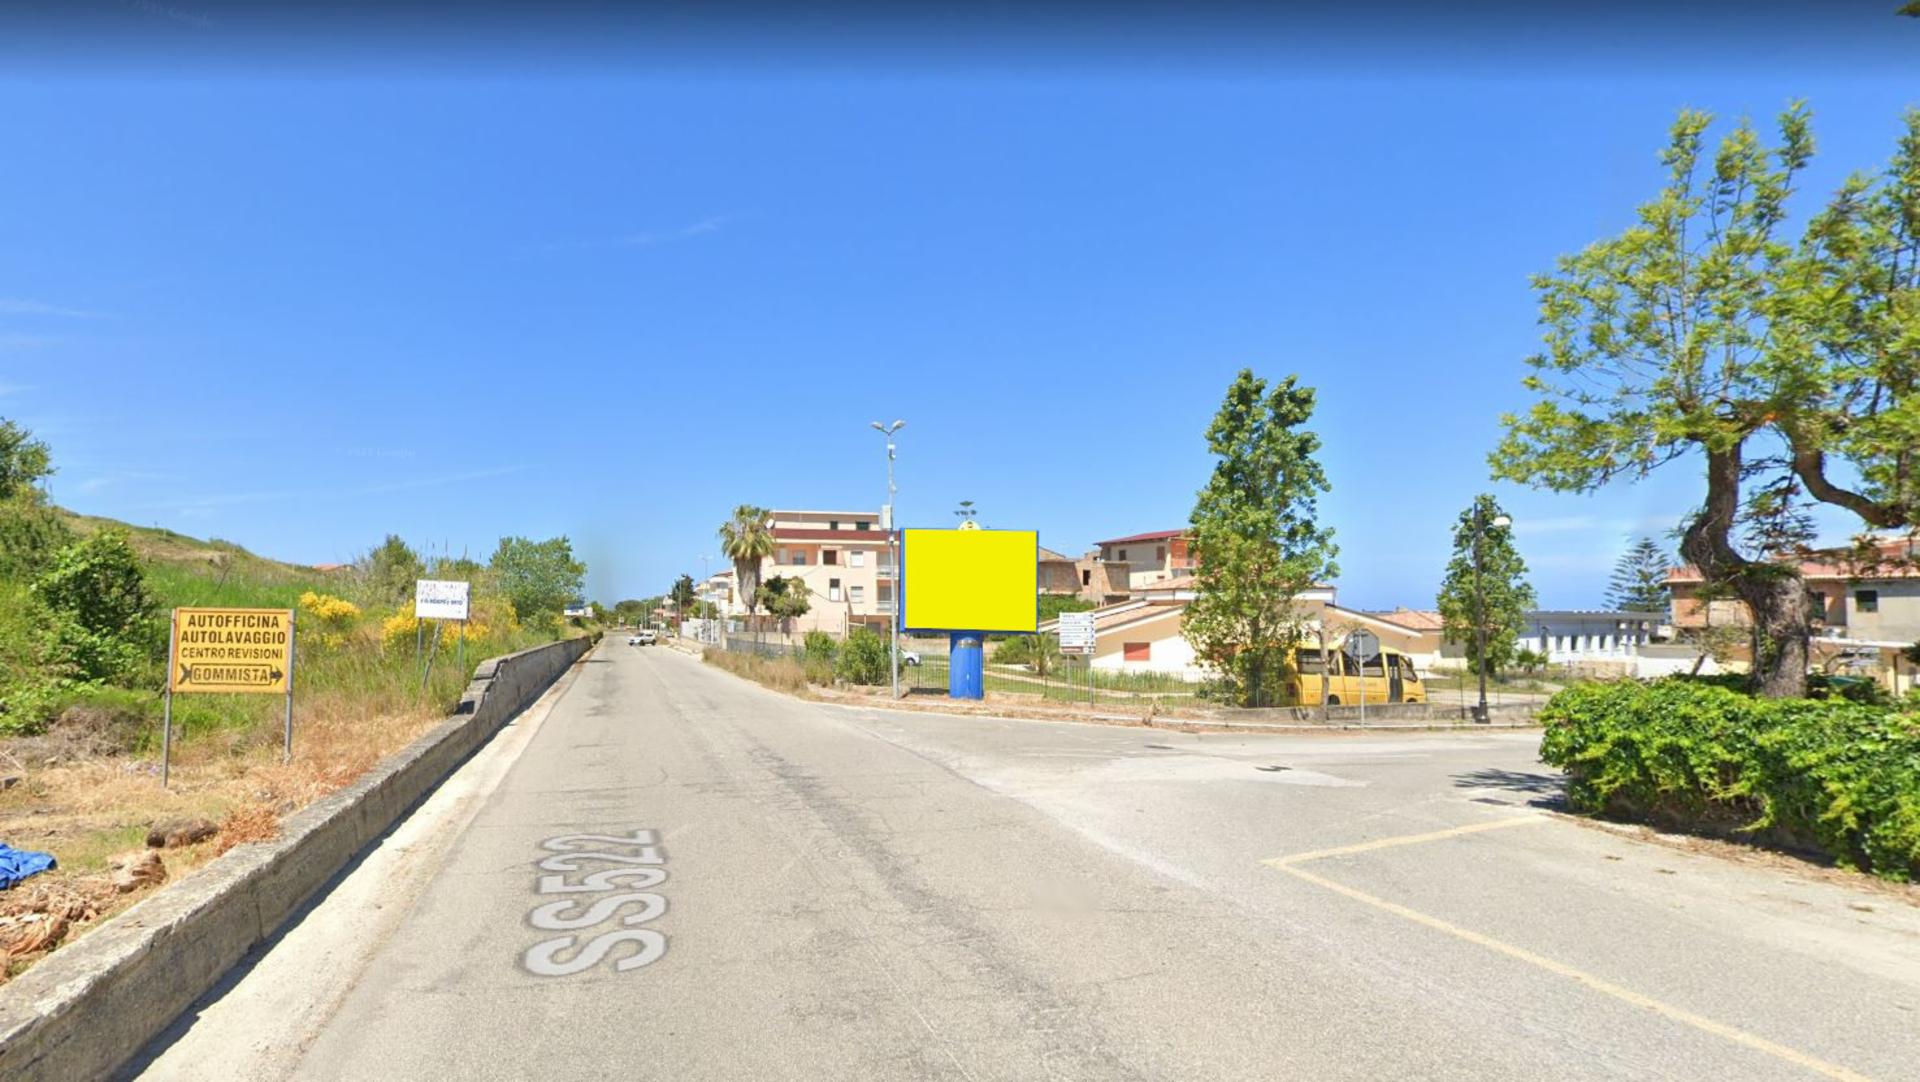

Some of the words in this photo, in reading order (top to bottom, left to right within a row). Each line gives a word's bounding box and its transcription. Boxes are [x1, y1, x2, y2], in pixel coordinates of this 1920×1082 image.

[187, 614, 280, 628] AUTOFFICINA
[181, 630, 286, 645] AUTOLAVAGGIO
[181, 647, 226, 659] CENTRO
[227, 648, 283, 660] REVISIONI
[193, 667, 269, 682] GOMMISTA
